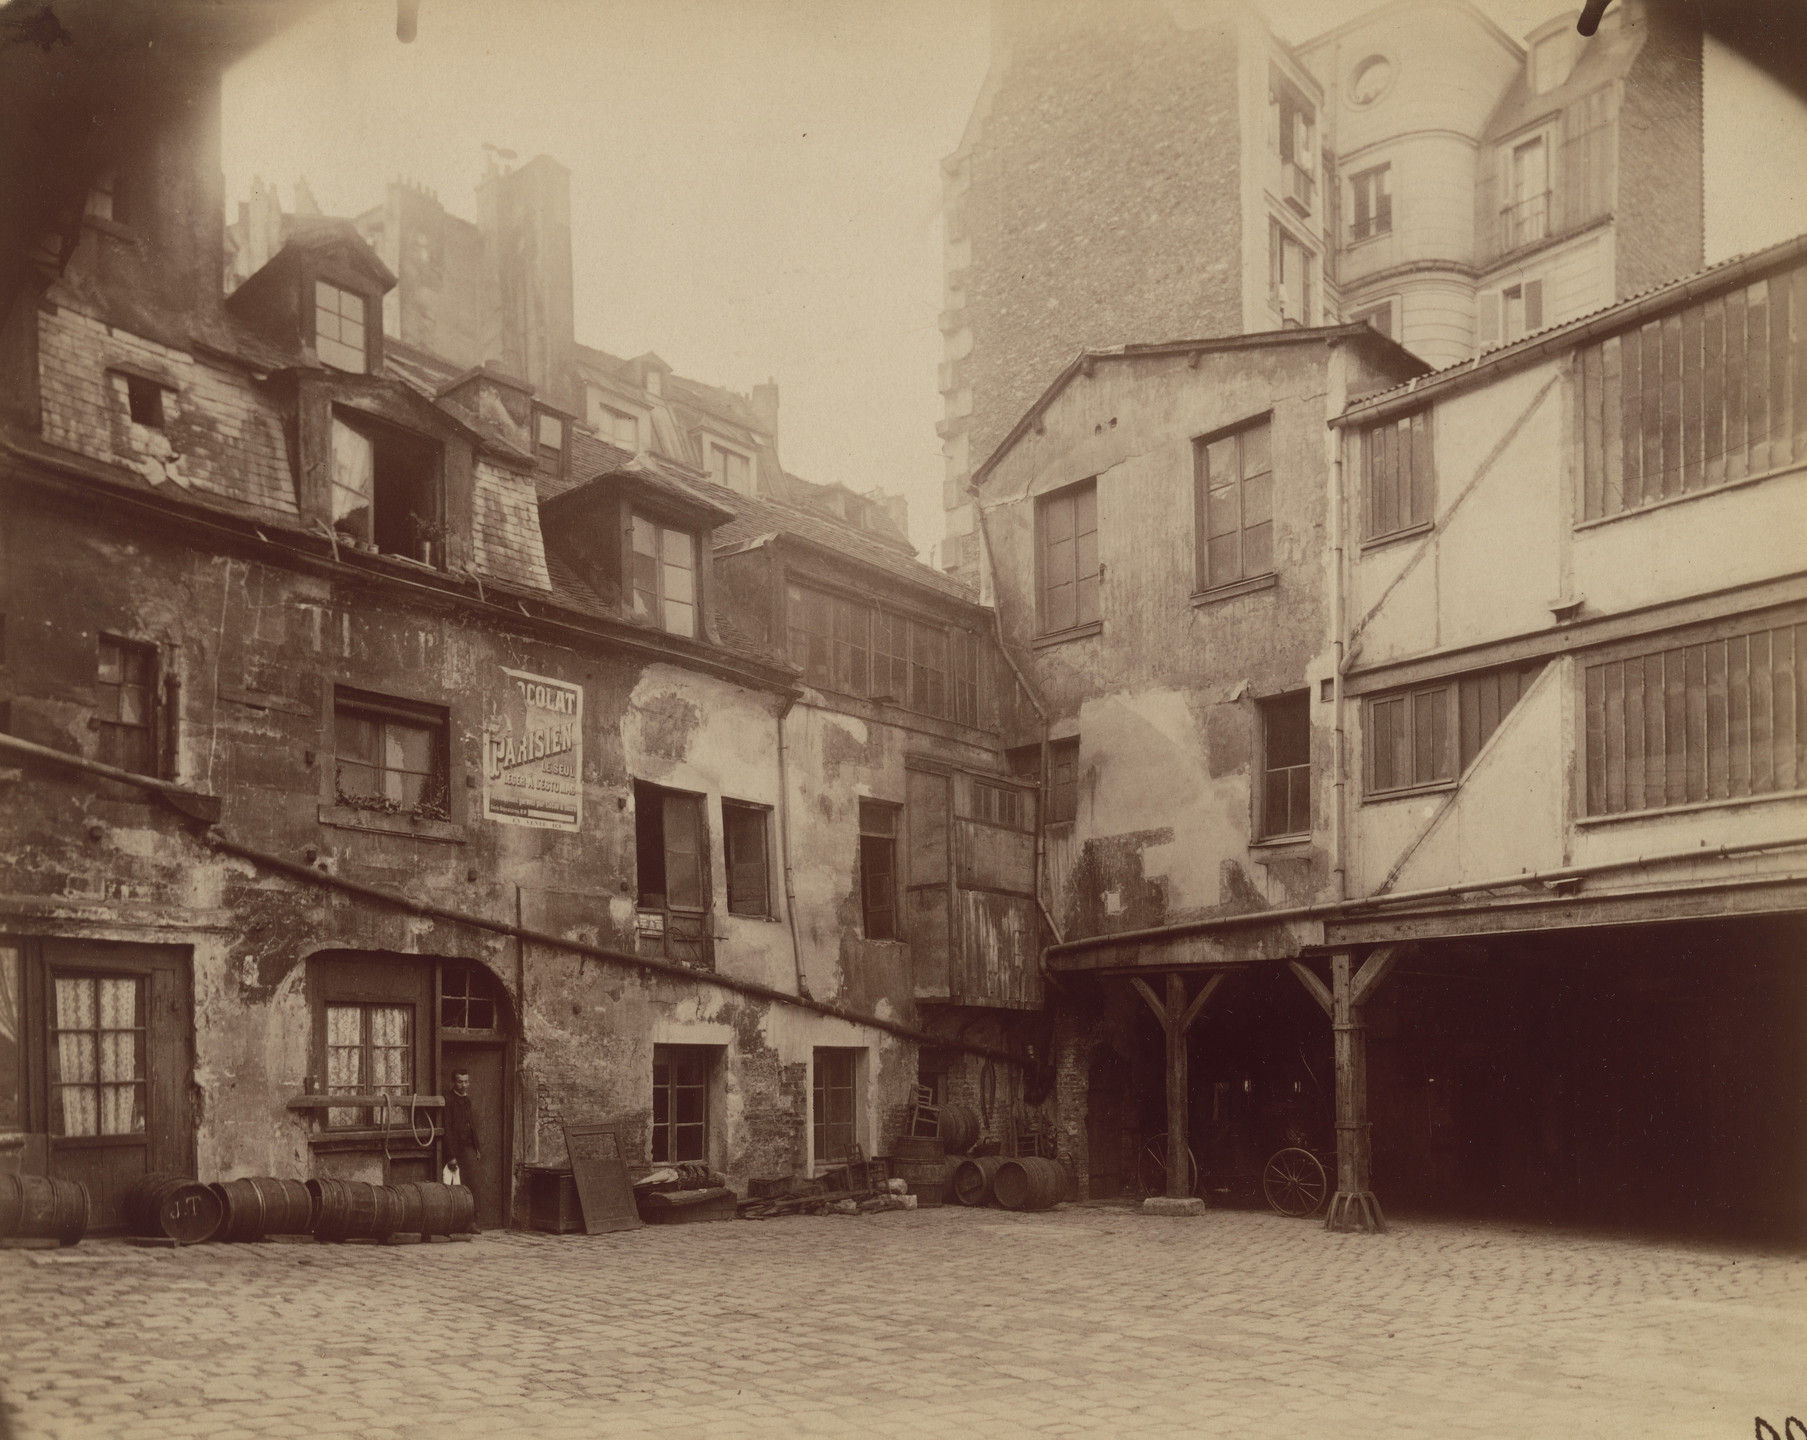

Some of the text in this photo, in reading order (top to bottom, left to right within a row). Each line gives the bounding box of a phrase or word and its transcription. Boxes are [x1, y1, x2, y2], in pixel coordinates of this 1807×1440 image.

[489, 722, 573, 780] PARISIEN
[541, 760, 575, 778] LE SEUL
